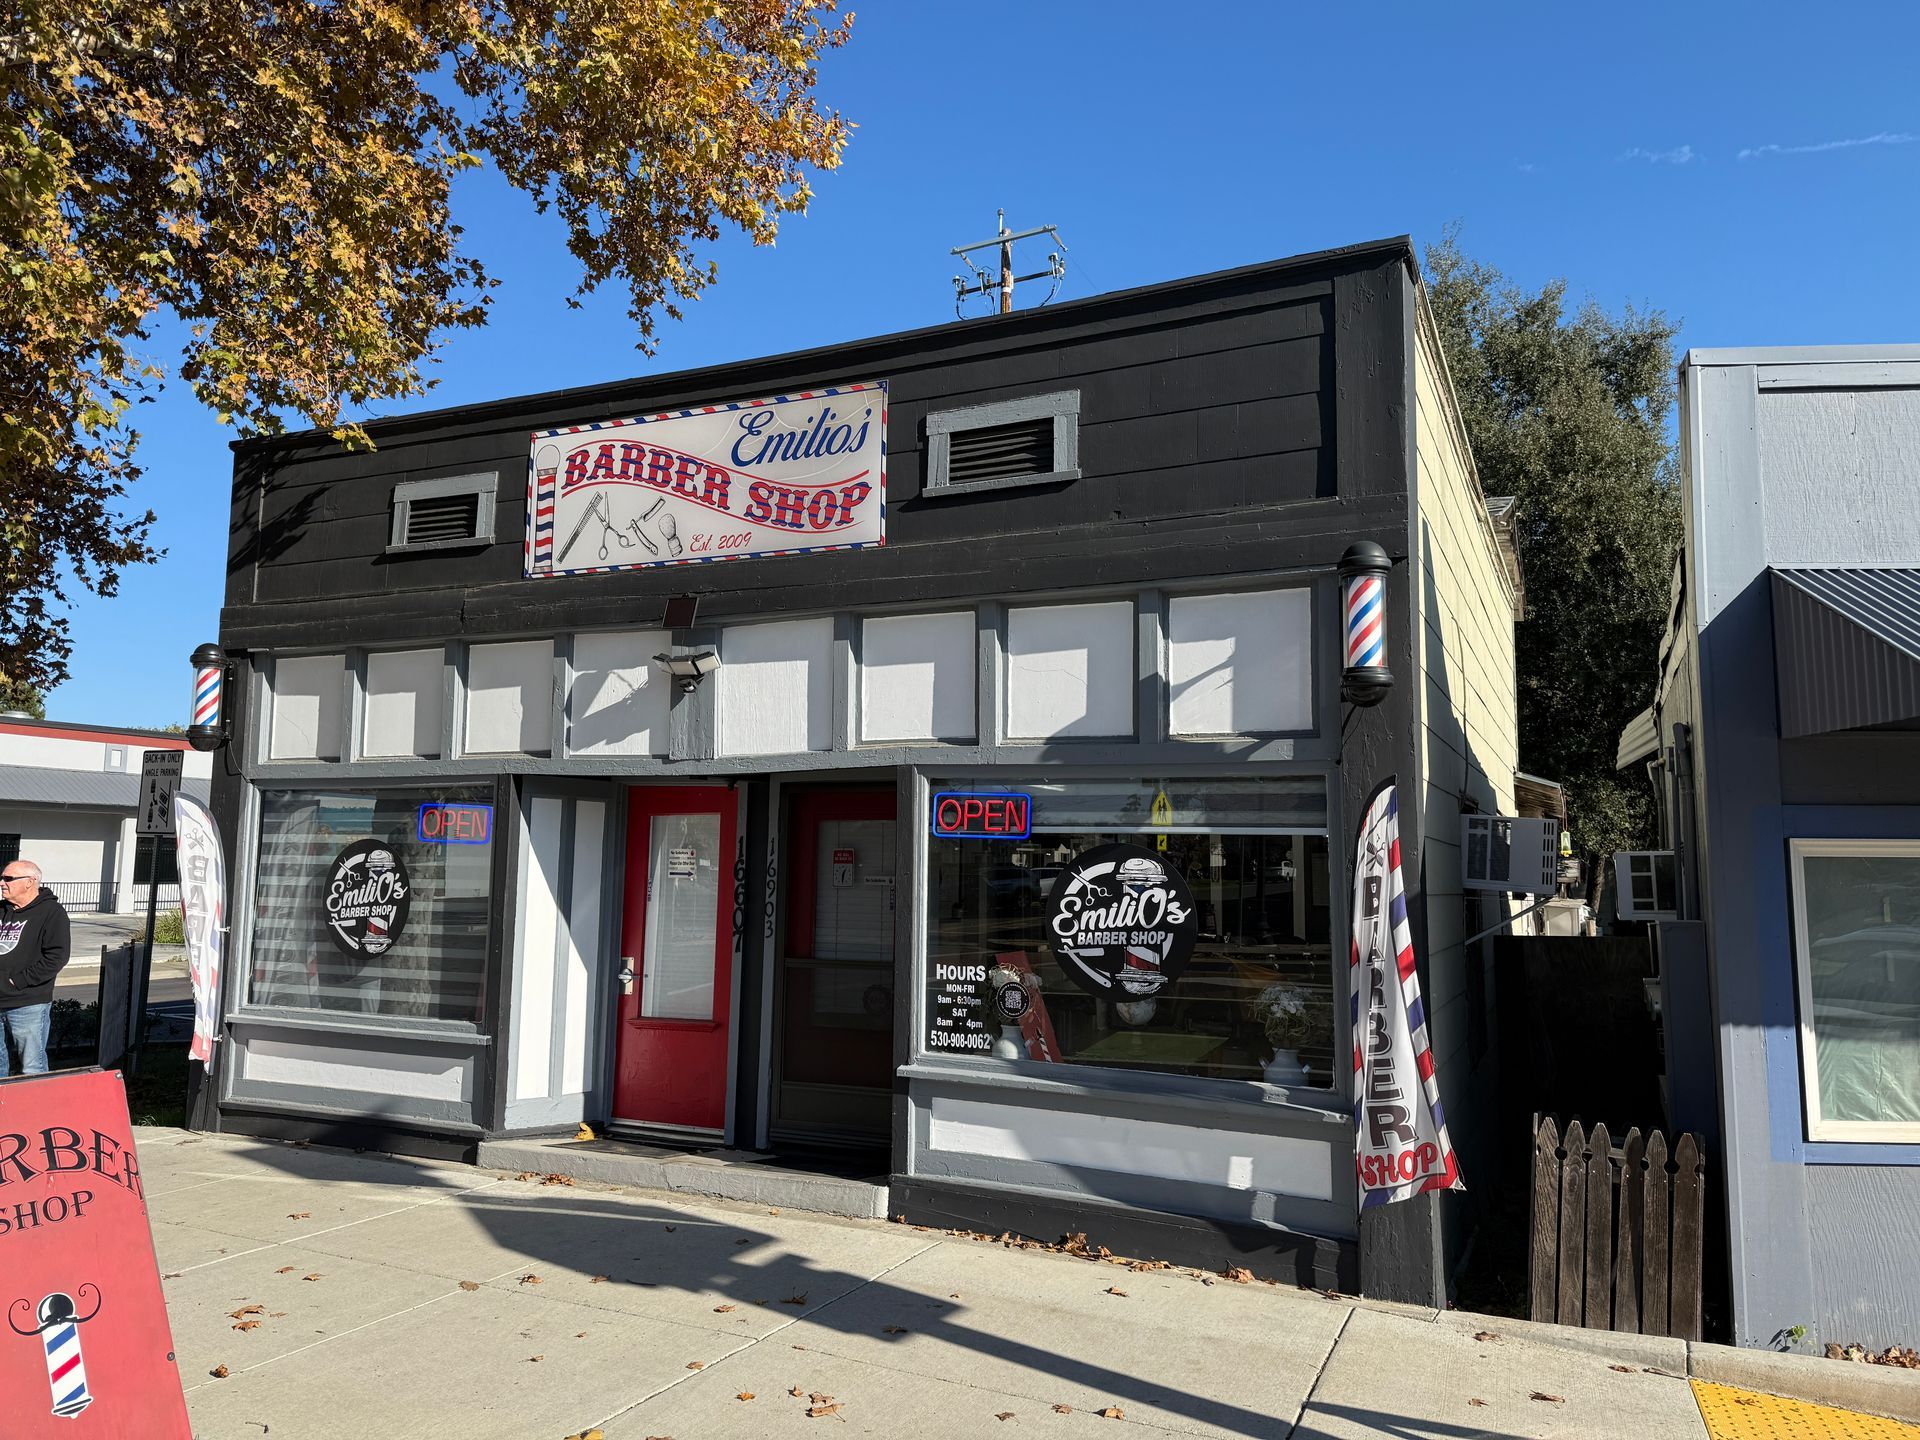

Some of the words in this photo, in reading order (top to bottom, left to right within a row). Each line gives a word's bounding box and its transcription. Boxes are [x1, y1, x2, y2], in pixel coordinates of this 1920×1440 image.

[561, 443, 731, 511] BARBER
[743, 480, 872, 531] SHOP
[690, 533, 713, 552] Est.
[717, 531, 752, 550] 2009
[145, 754, 165, 763] BACK-IN
[167, 753, 181, 763] ONLY
[145, 768, 158, 776] ANGLE
[160, 768, 178, 776] PARKING
[422, 809, 488, 838] OPEN
[938, 799, 1027, 832] OPEN
[765, 837, 777, 939] 16903
[340, 906, 370, 919] BARBER
[371, 904, 392, 917] SHOP
[1077, 931, 1128, 945] BARBER
[1130, 931, 1166, 945] SHOP
[936, 964, 986, 982] HOURS
[946, 984, 975, 994] MON-FRI
[937, 995, 952, 1004] 9am
[957, 995, 982, 1007] 6:30pm
[952, 1008, 968, 1017] SAT
[936, 1017, 953, 1027] 8am
[966, 1019, 983, 1030] 4pm
[930, 1030, 991, 1050] 530-908-0062
[0, 1127, 144, 1200] RBER
[1363, 1142, 1438, 1187] SHOP
[0, 1190, 94, 1235] SHOP
